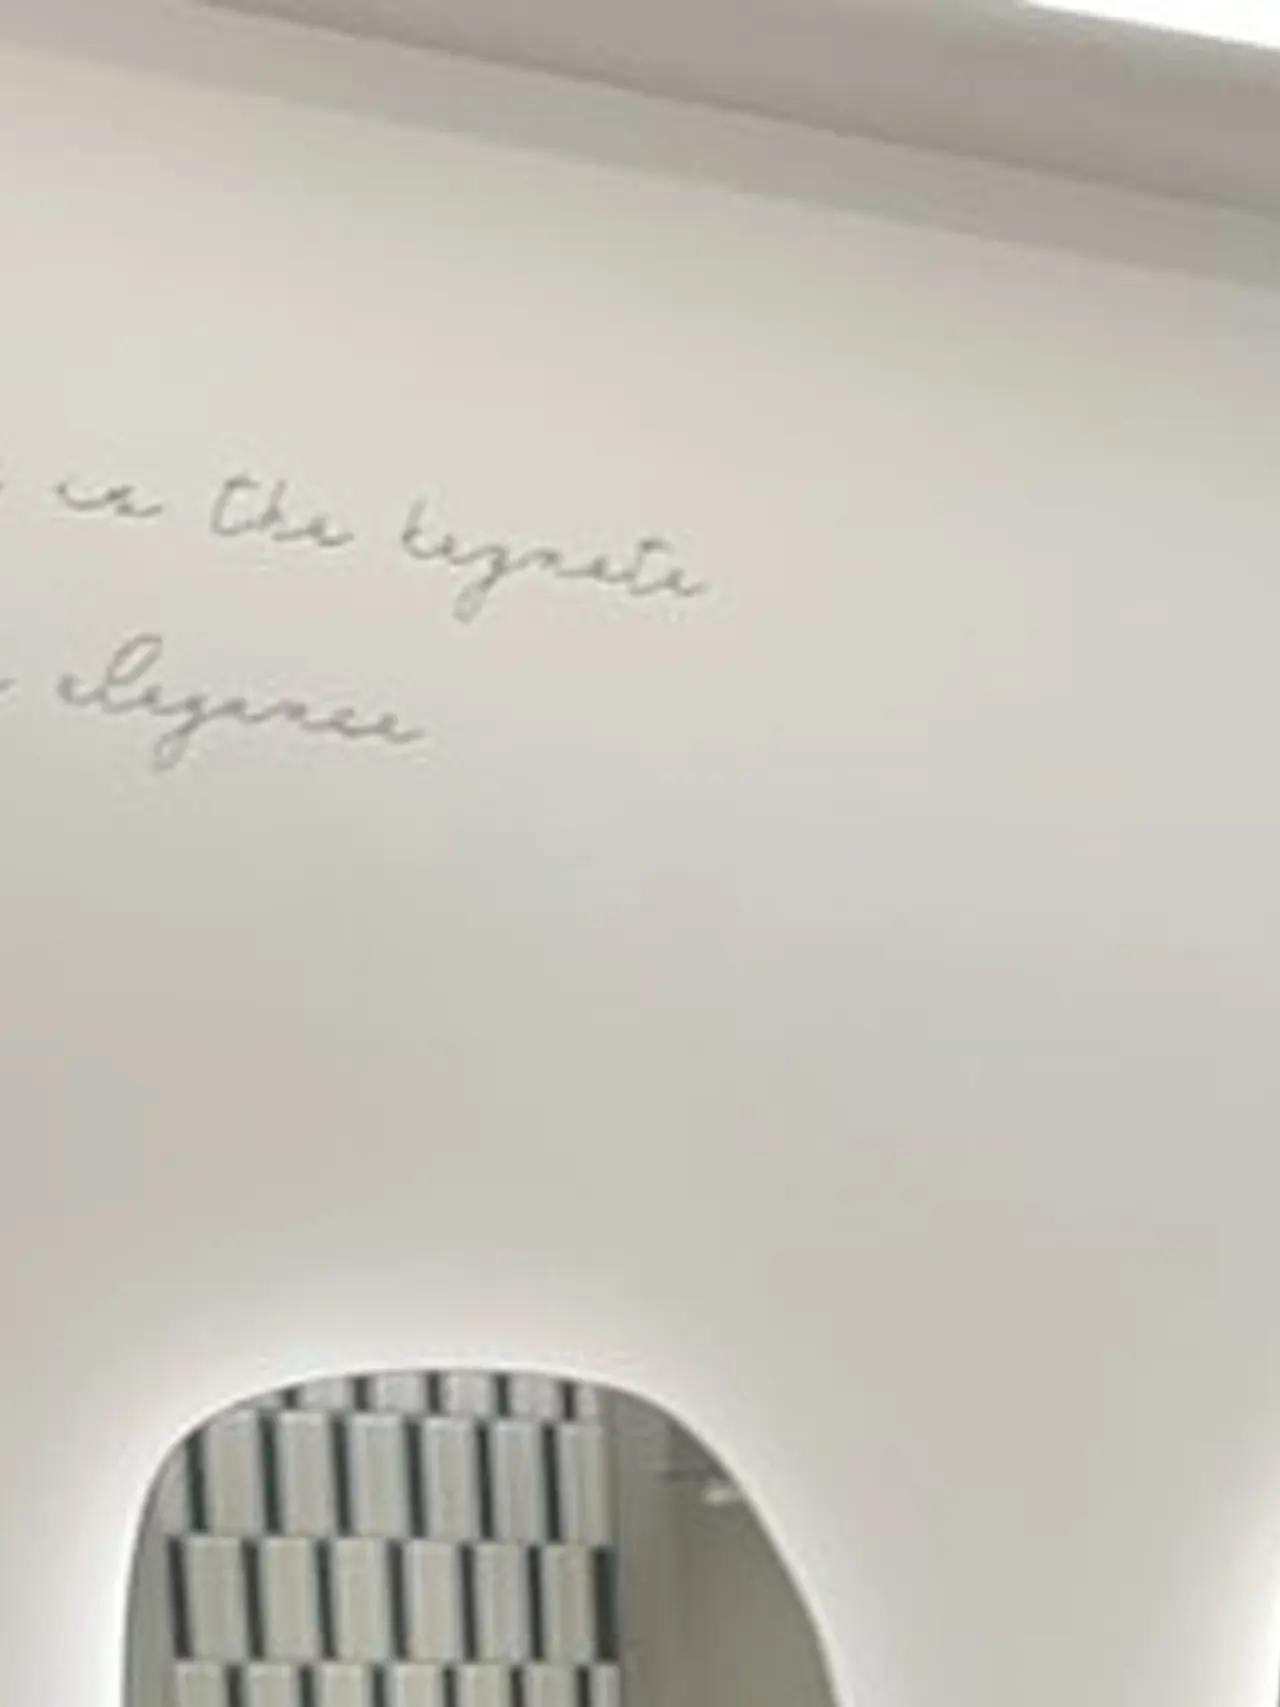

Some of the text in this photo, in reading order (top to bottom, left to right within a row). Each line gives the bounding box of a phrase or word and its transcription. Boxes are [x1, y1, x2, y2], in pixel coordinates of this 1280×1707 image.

[209, 473, 355, 548] the
[398, 499, 709, 624] keynote
[54, 631, 425, 773] elegance
